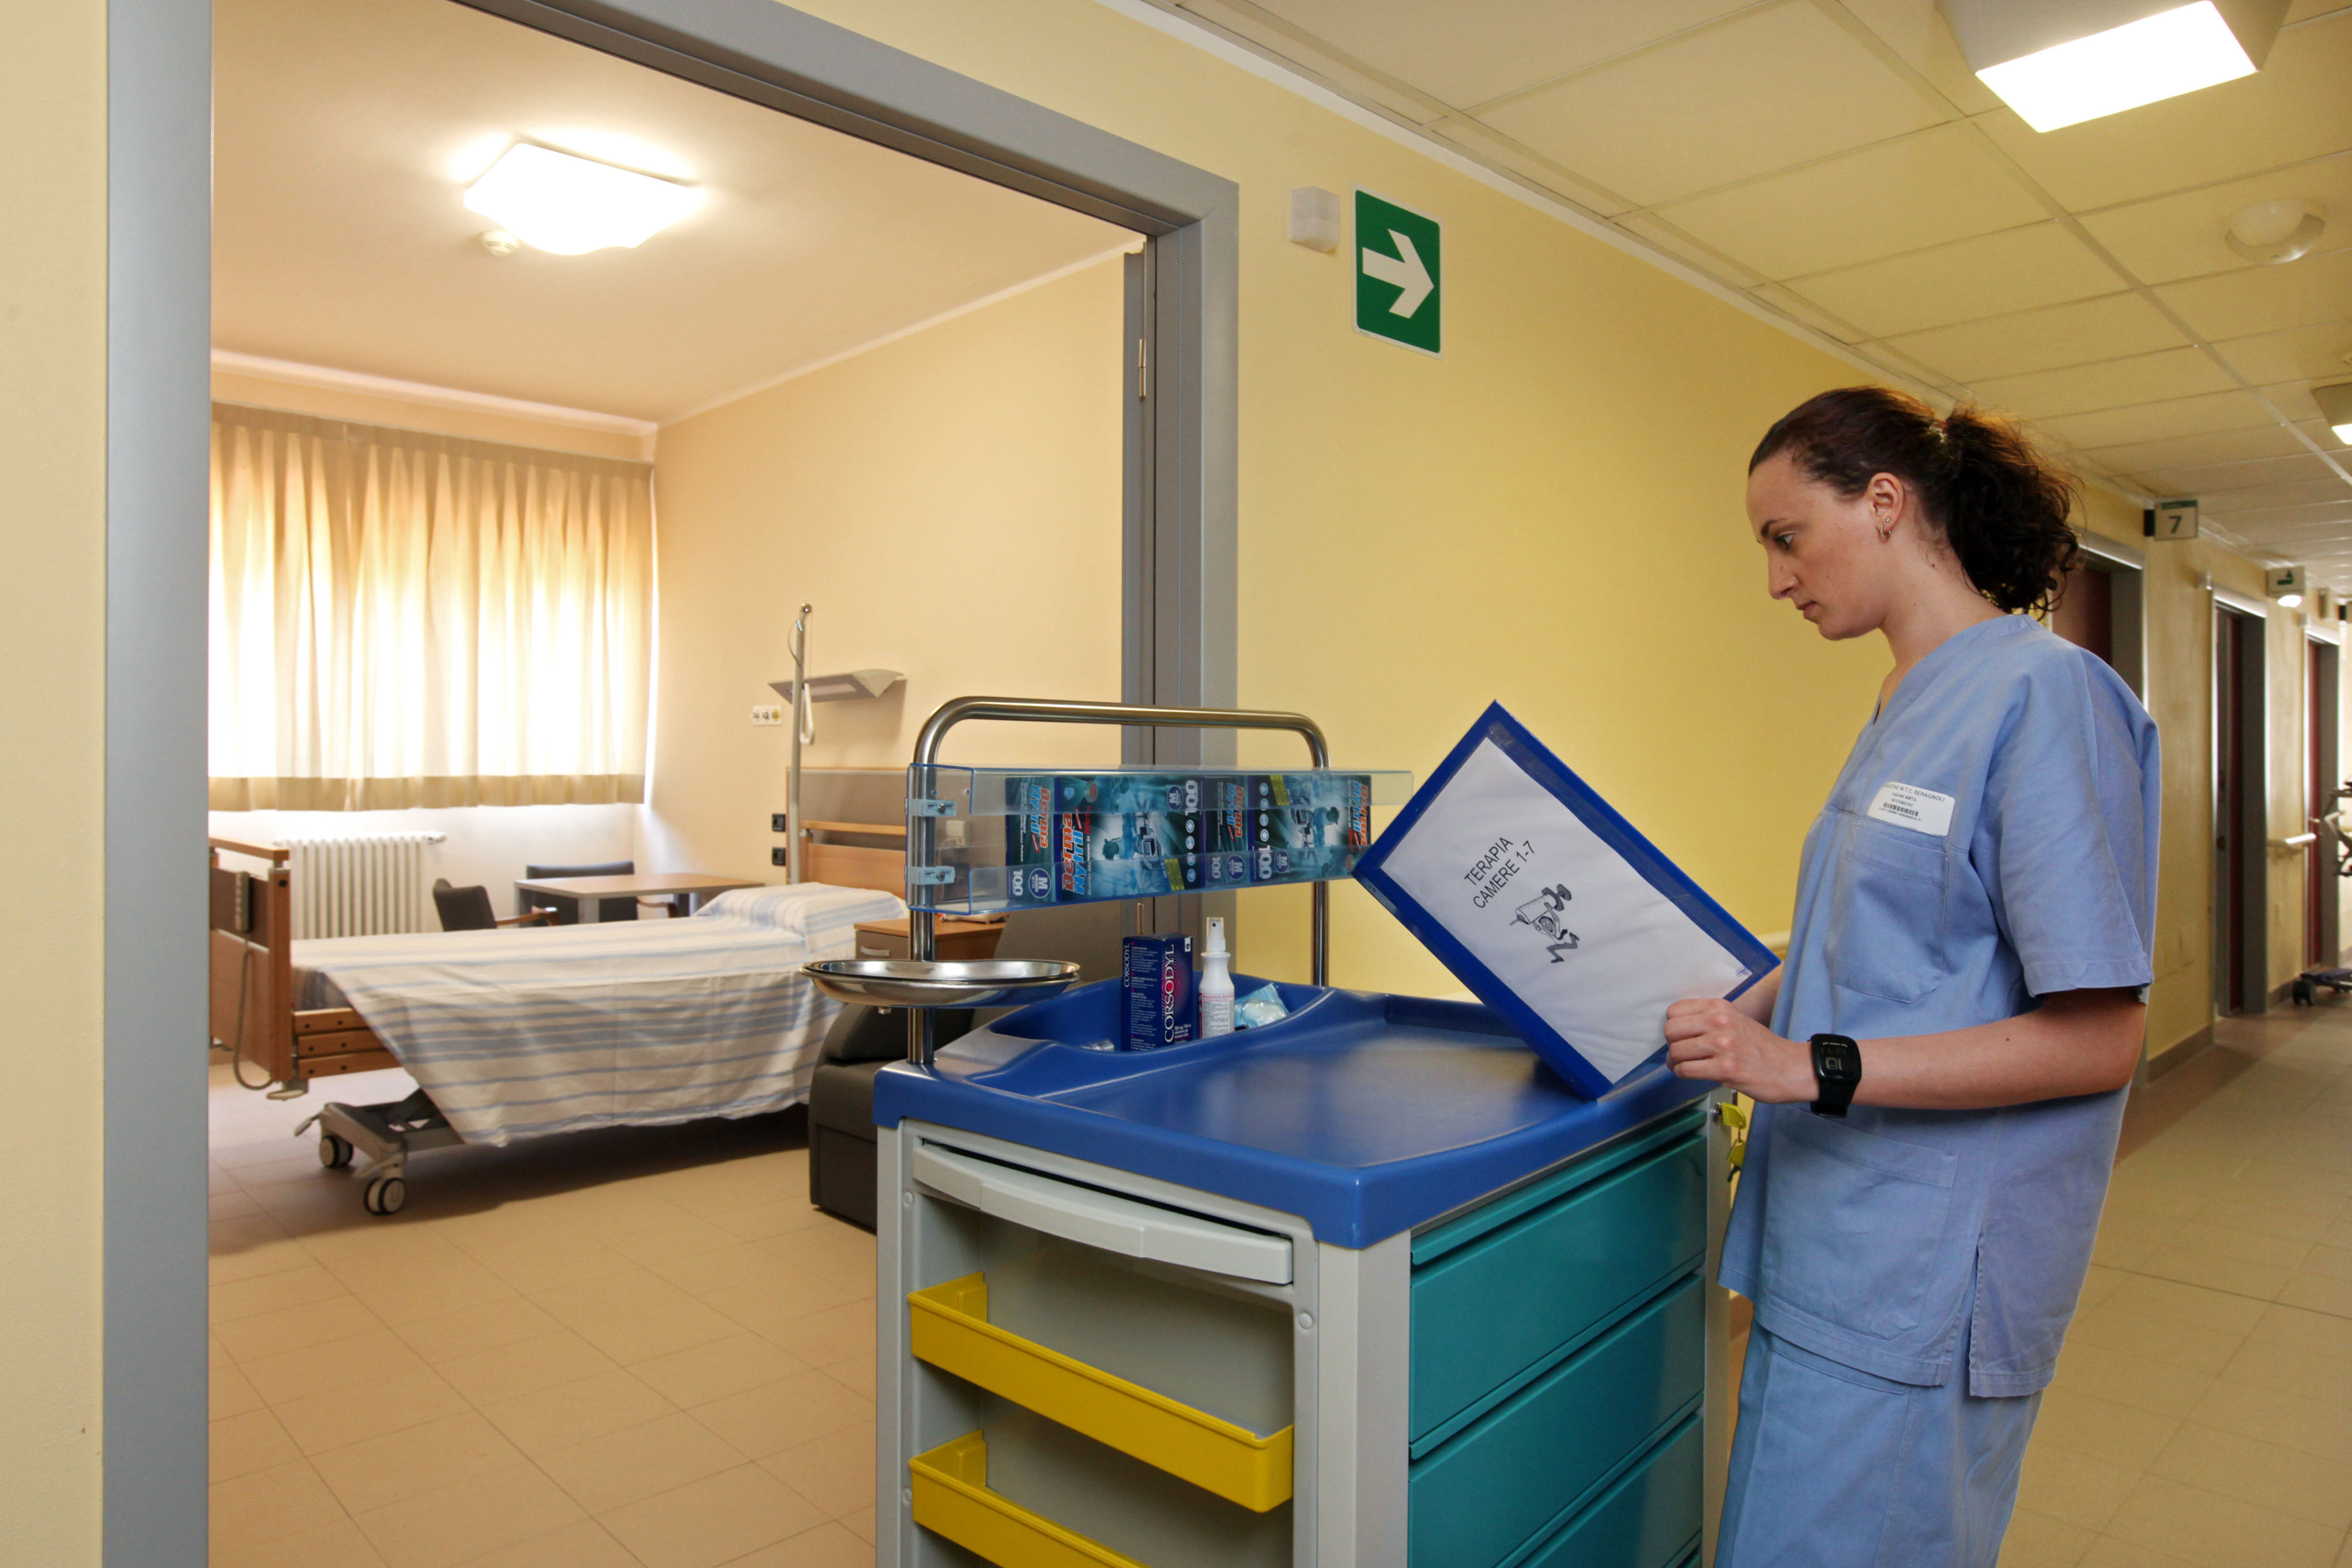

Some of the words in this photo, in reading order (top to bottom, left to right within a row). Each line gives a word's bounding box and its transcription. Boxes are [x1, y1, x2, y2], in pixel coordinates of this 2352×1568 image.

[2169, 515, 2183, 534] 7
[1030, 783, 1041, 835] Nytril
[1169, 793, 1177, 804] M
[1185, 780, 1198, 816] 100
[1914, 790, 1946, 802] SERAGNOLI
[1040, 787, 1051, 849] Derma
[1062, 813, 1075, 893] Derma
[1072, 829, 1087, 895] Nytril
[1212, 856, 1221, 879] 100
[1234, 862, 1243, 873] M
[1258, 845, 1272, 880] 100
[1281, 856, 1288, 866] M
[1464, 837, 1513, 886] TERAPIA
[1013, 869, 1023, 896] 100
[1038, 877, 1048, 890] M
[1473, 859, 1520, 909] CAMERE
[1516, 840, 1535, 862] 1-7
[1164, 944, 1175, 1043] CORSODYL
